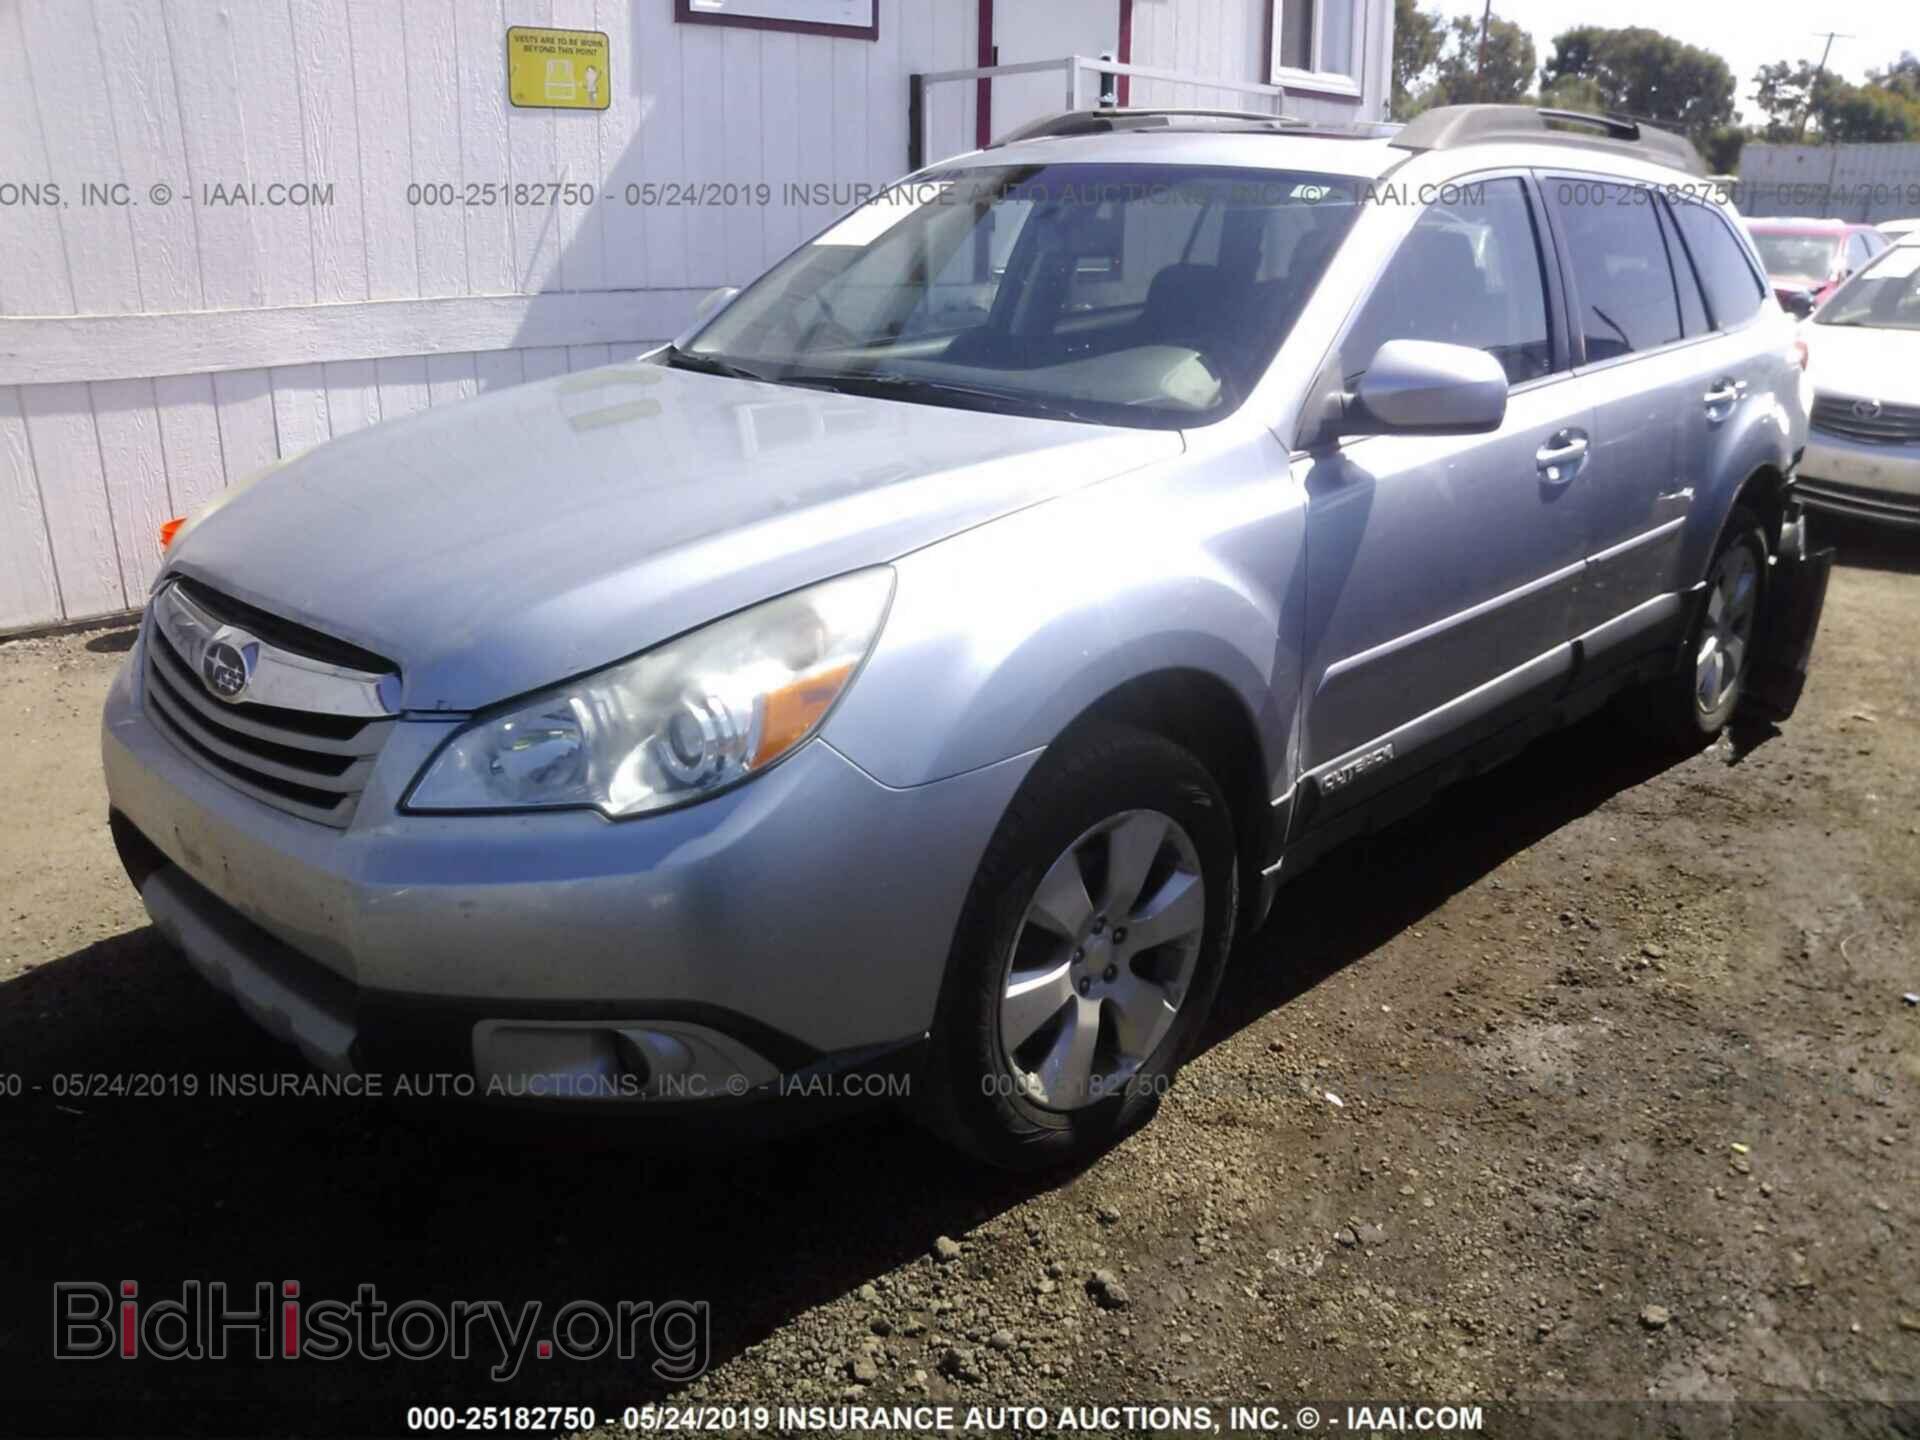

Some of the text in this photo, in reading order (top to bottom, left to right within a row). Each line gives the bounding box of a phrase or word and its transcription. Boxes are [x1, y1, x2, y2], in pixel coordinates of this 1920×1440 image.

[513, 35, 604, 48] VESTS ARE TO BE WORN
[523, 45, 598, 57] BEYOND THIS POINT
